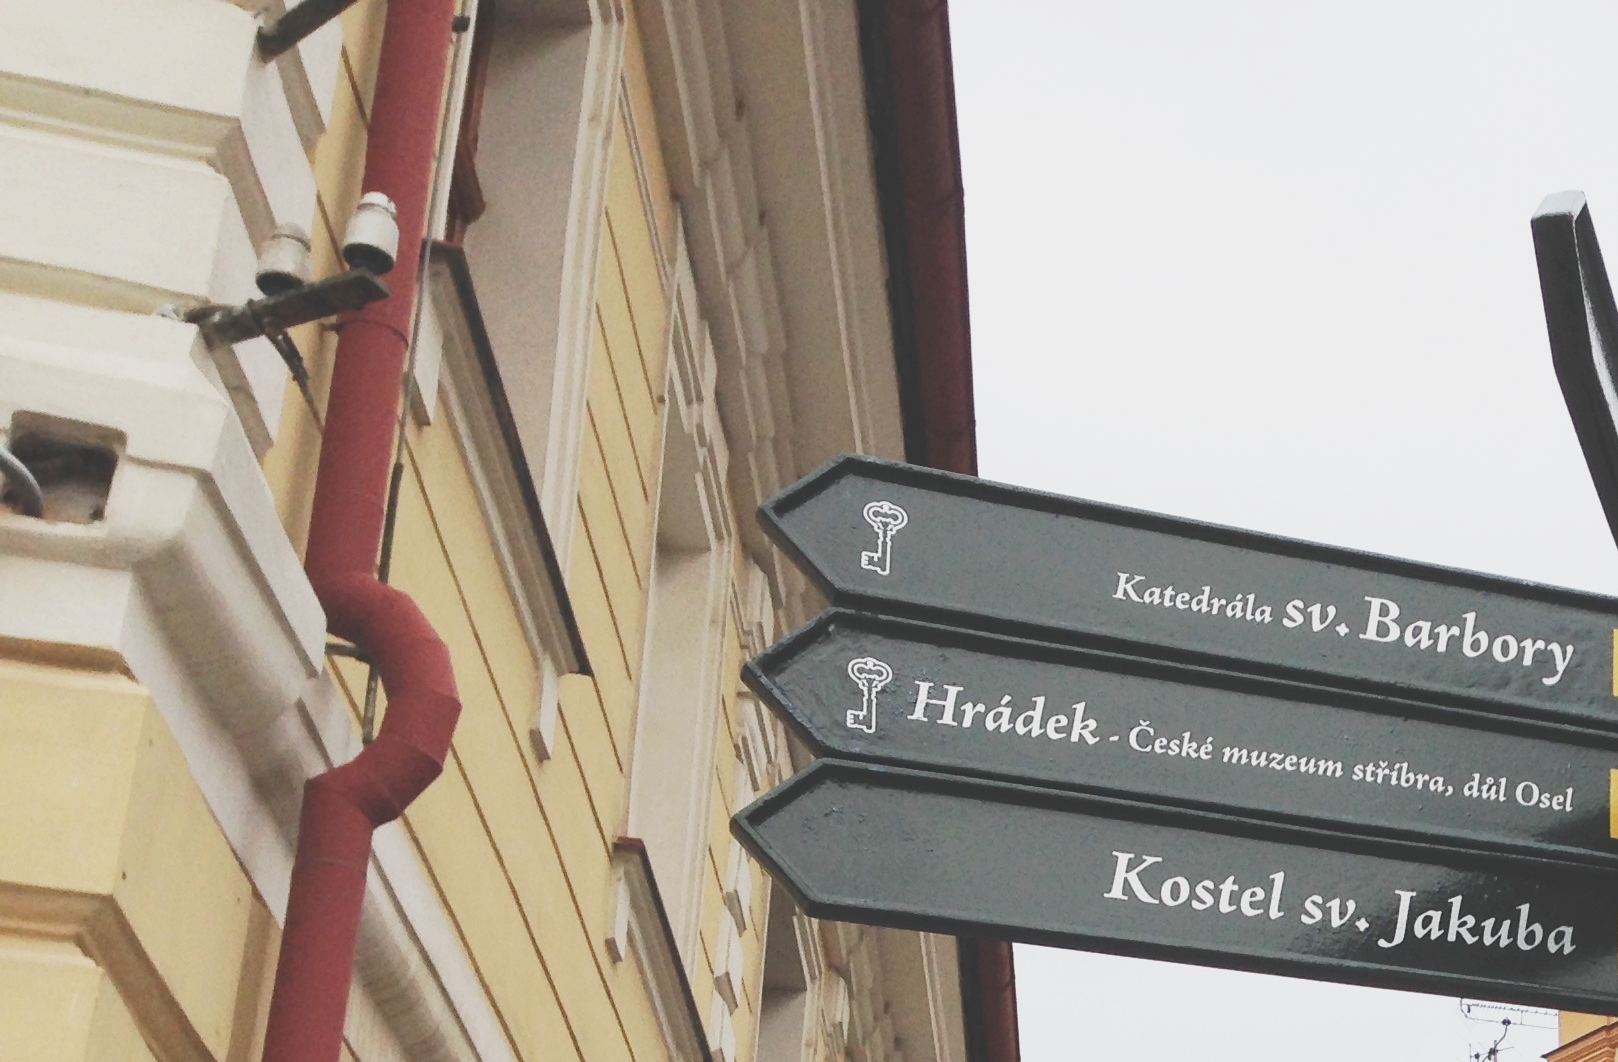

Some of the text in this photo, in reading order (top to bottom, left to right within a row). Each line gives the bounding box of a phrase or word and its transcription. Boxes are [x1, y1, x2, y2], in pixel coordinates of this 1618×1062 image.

[1112, 571, 1574, 686] Katedrála sv. Barbory
[906, 680, 1101, 745] Hrádek
[1129, 719, 1214, 760] České
[1222, 746, 1344, 778] muzeum
[1352, 760, 1454, 797] stříbra,
[1463, 772, 1507, 802] důl
[1515, 781, 1574, 812] Osel
[1103, 850, 1576, 955] Kostel sv. Jakuba
